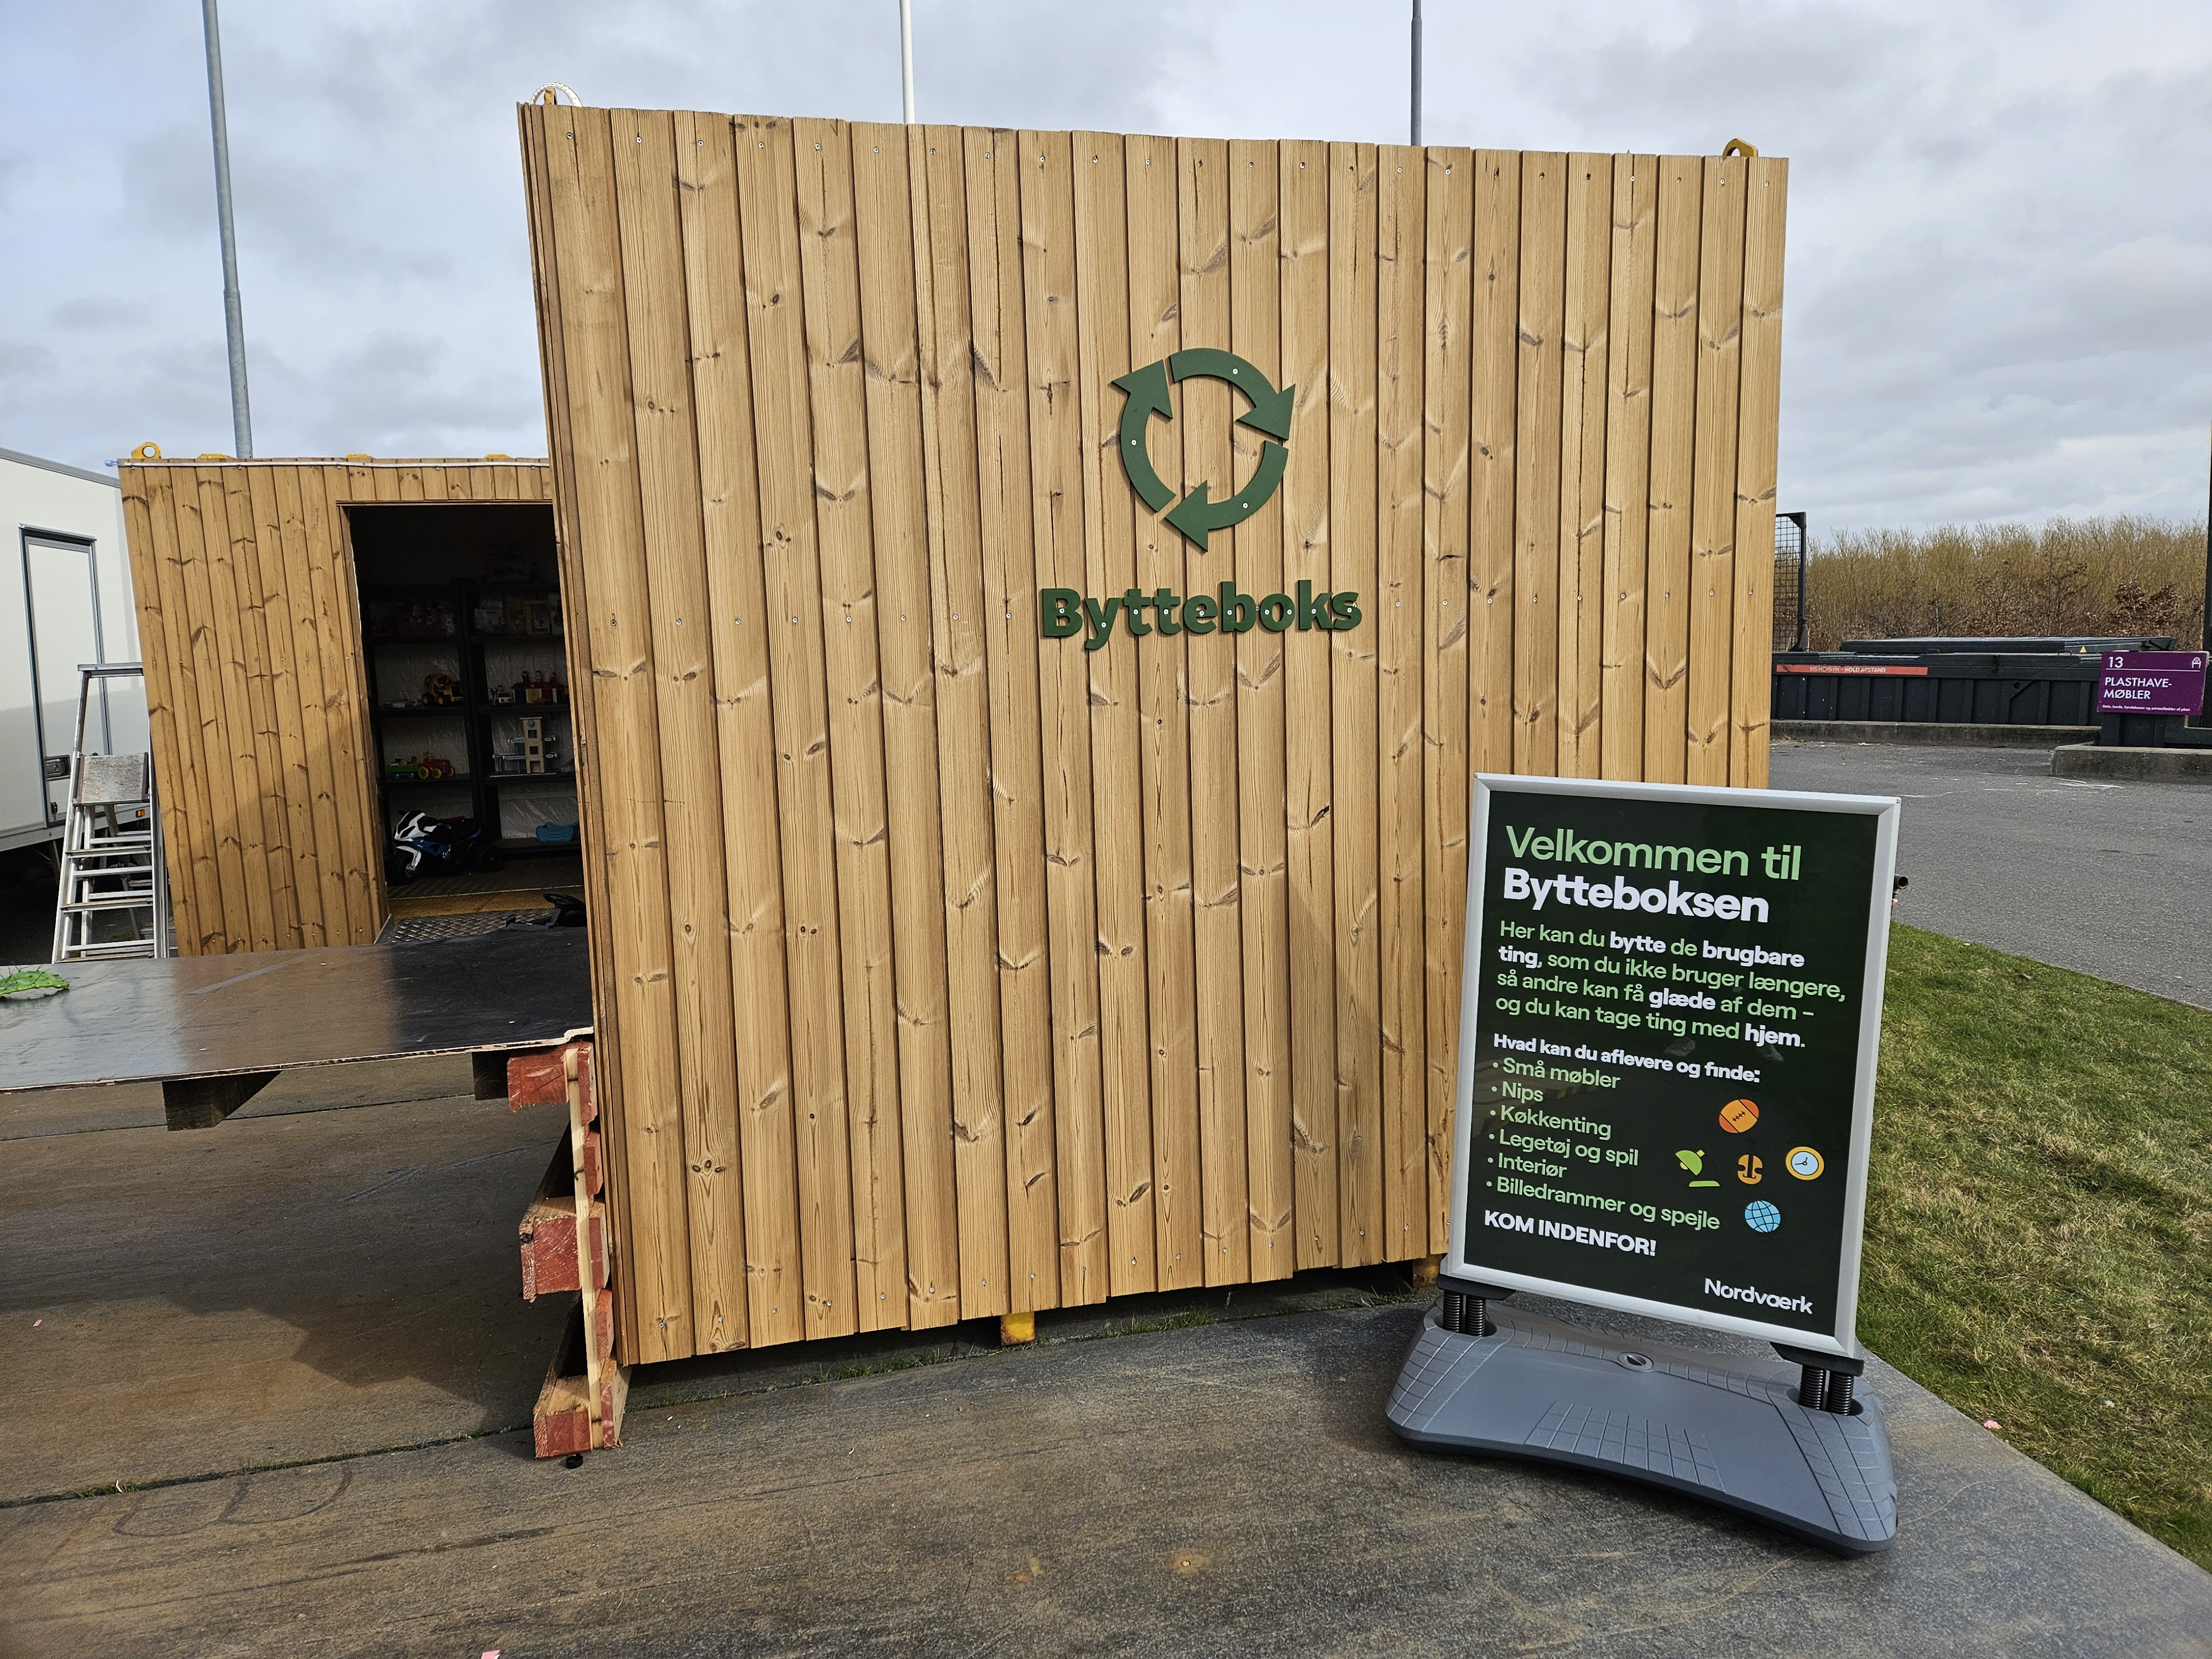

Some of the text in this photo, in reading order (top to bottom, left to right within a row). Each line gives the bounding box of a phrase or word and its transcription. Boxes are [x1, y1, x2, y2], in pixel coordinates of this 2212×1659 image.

[1041, 579, 1363, 650] Bytteboks
[2105, 677, 2172, 688] PLASTHAVE-
[2108, 656, 2124, 669] 13
[2104, 689, 2151, 700] MØBLER
[1505, 825, 1802, 880] Velkommen til
[1504, 867, 1769, 923] Bytteboksen
[1500, 920, 1805, 967] Her kan du bytte de brugbare
[1497, 969, 1517, 987] så
[1522, 975, 1578, 994] andre
[1583, 978, 1619, 999] kan
[1623, 983, 1644, 1002] få
[1648, 987, 1716, 1010] glæde
[1720, 996, 1744, 1013] af
[1747, 998, 1797, 1020] dem
[1498, 945, 1845, 1002] ting, som du ikke bruger længere,
[1495, 998, 1806, 1047] og du kan tage ting med hjem.
[1494, 1033, 1760, 1083] Hvad kan du aflevere og finde:
[1503, 1057, 1621, 1089] Små møbler
[1502, 1081, 1543, 1104] Nips
[1500, 1104, 1611, 1140] Køkkenting
[1498, 1152, 1567, 1178] Interiør
[1499, 1129, 1639, 1167] Legetøj og spil
[1497, 1176, 1720, 1231] Billedrammer og spejle
[1484, 1209, 1657, 1257] KOM INDENFOR!
[1704, 1277, 1813, 1314] Nordværk
